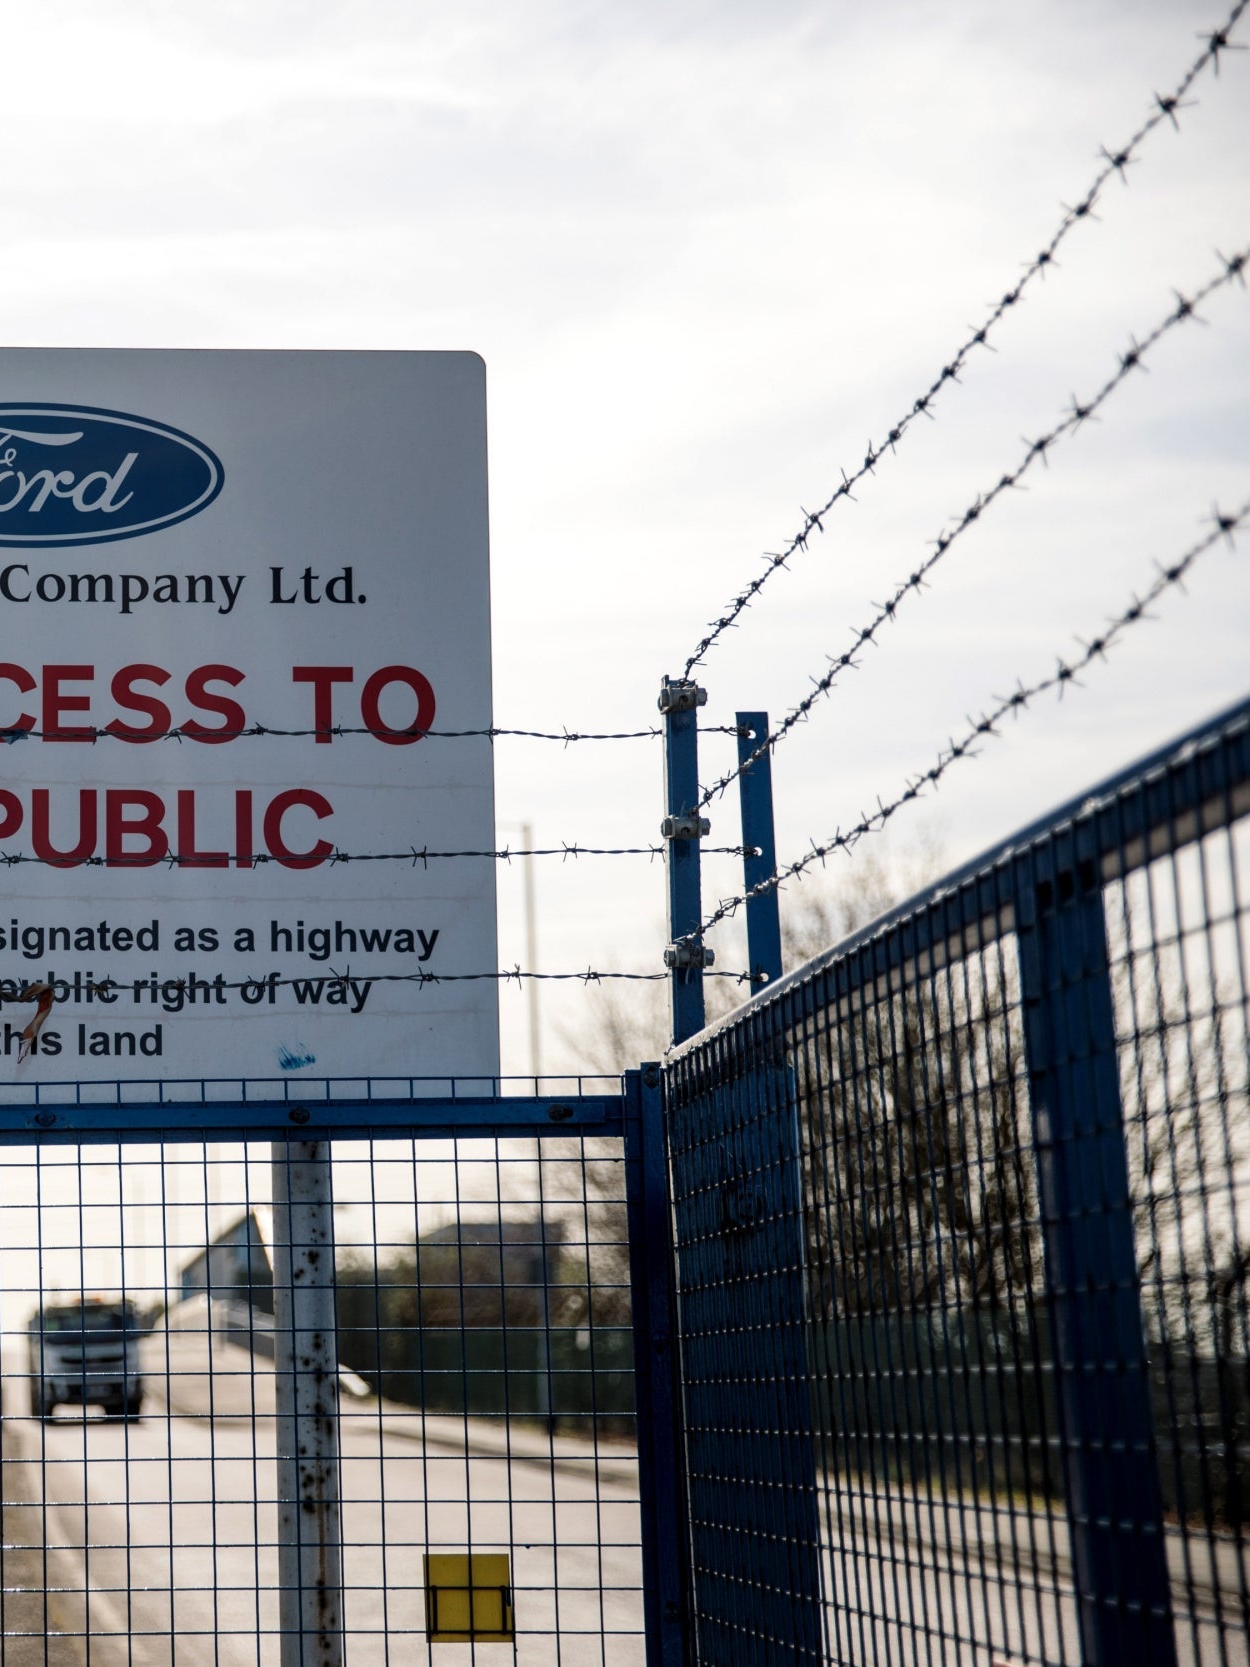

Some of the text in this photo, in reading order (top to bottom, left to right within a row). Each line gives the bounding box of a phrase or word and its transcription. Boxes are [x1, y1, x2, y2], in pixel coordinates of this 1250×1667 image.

[0, 565, 245, 615] Company
[269, 566, 367, 605] Ltd.
[292, 666, 436, 744] TO
[173, 927, 219, 952] as
[233, 927, 256, 952] a
[270, 920, 440, 962] highway
[132, 972, 226, 1012] right
[239, 972, 281, 1004] of
[291, 979, 371, 1013] way
[78, 1023, 163, 1057] land
